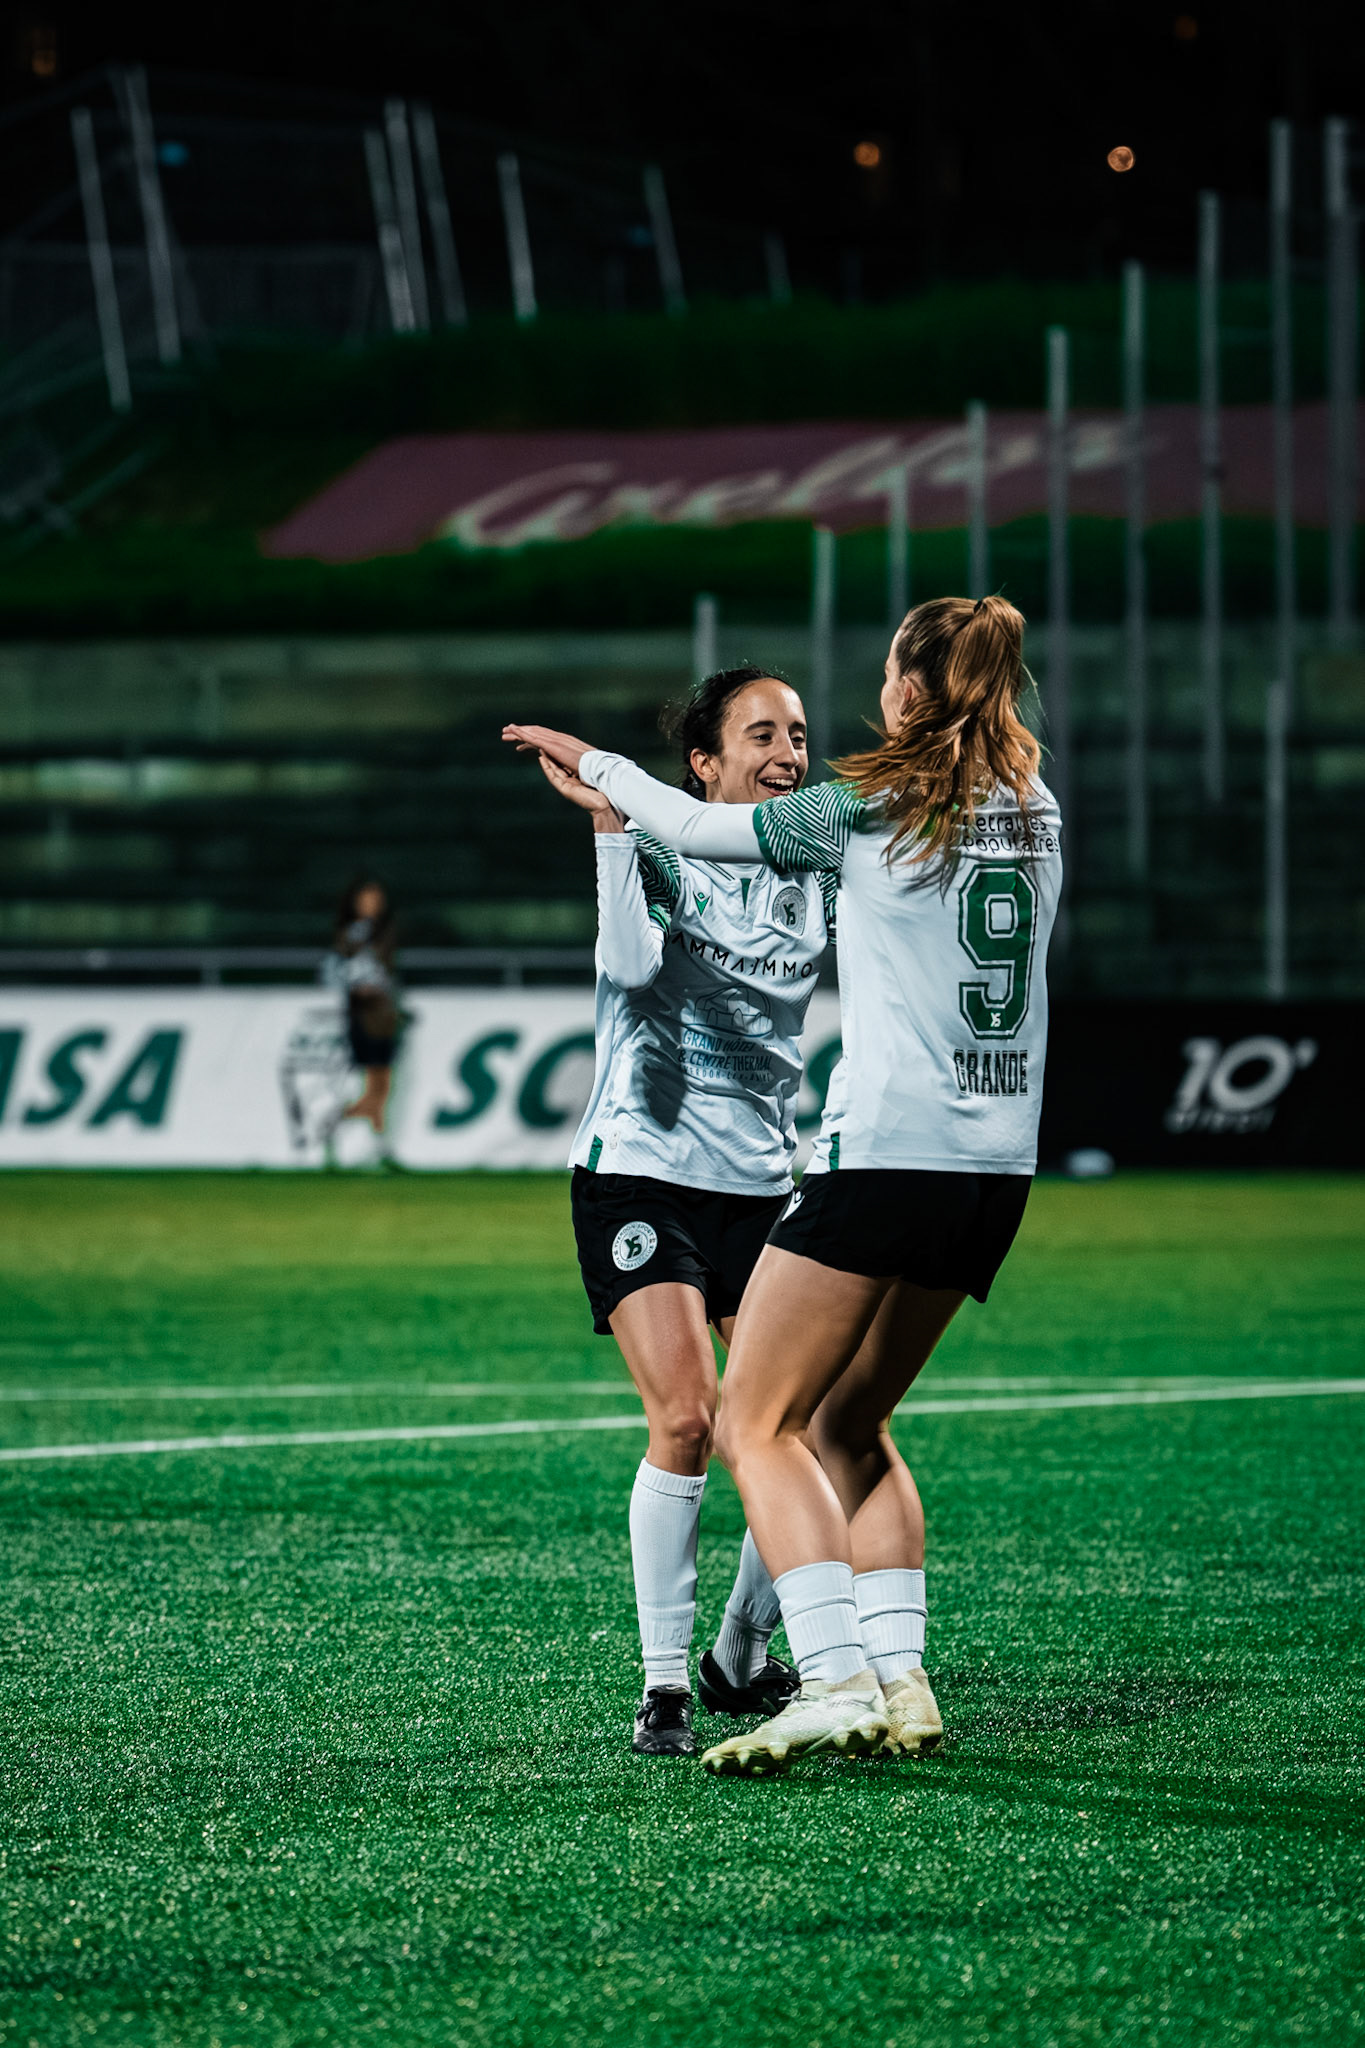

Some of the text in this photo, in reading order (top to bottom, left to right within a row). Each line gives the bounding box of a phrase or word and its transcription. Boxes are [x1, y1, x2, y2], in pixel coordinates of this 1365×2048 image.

[958, 862, 1038, 1039] 9
[683, 1030, 723, 1052] GRAND
[678, 1049, 773, 1072] & CENTRE THERMAL
[954, 1049, 1028, 1096] GRANDE
